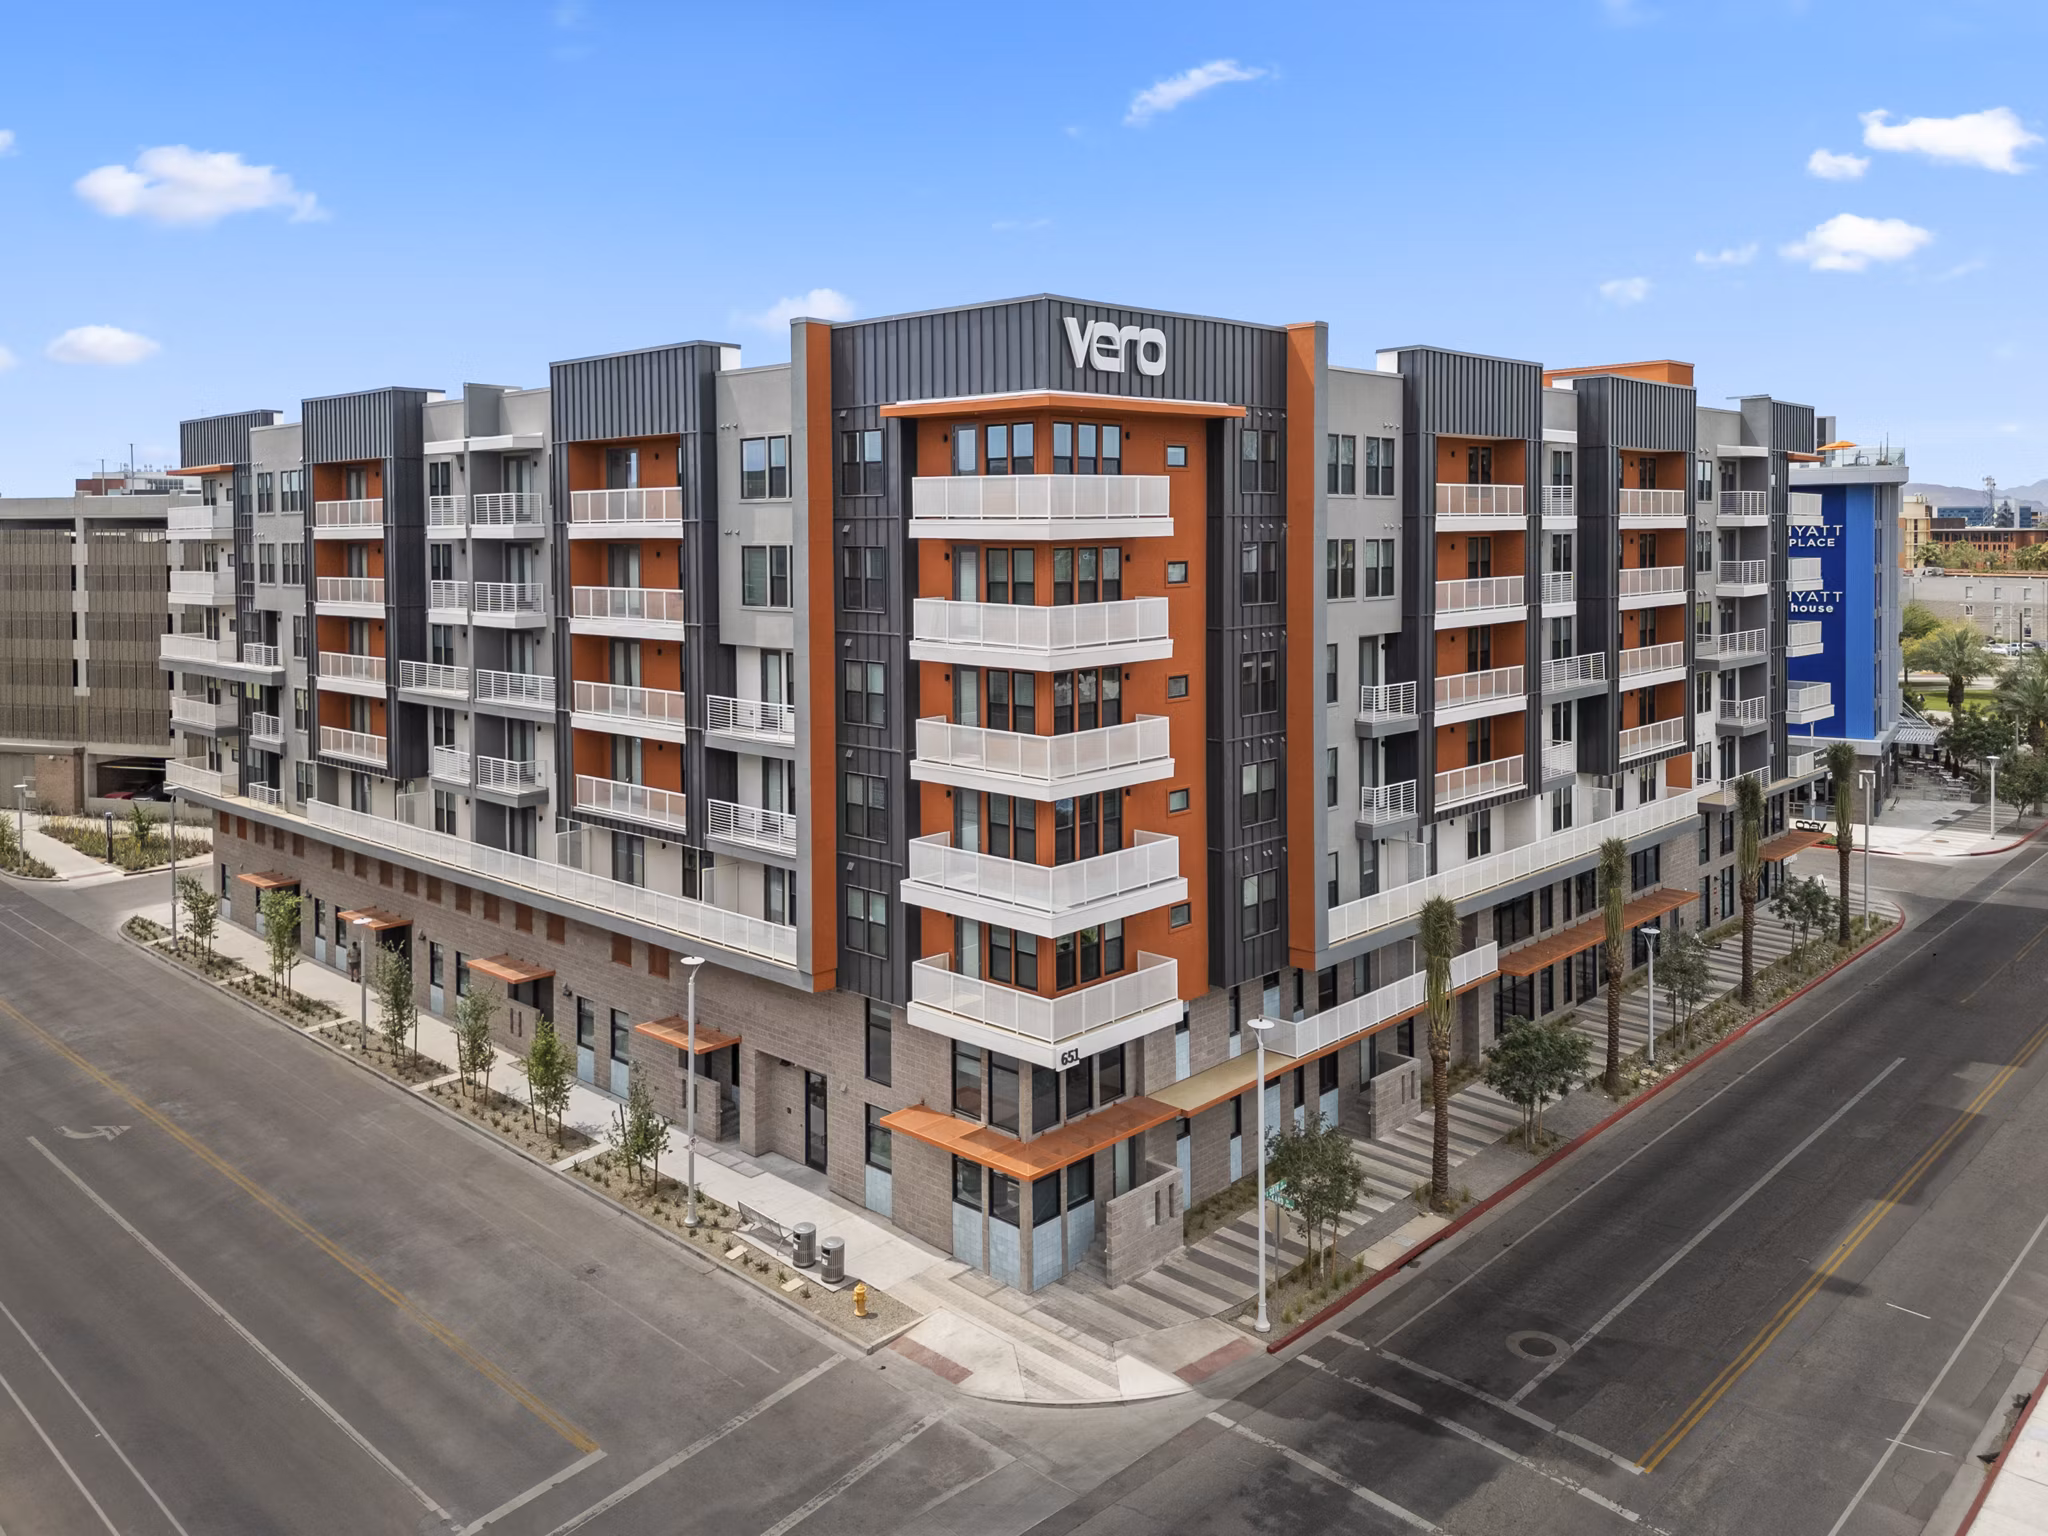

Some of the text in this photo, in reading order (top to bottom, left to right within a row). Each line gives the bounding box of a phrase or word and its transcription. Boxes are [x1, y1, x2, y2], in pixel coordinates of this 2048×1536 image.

[1789, 538, 1835, 547] PLACE
[1791, 602, 1834, 613] house
[1061, 1047, 1080, 1065] 651
